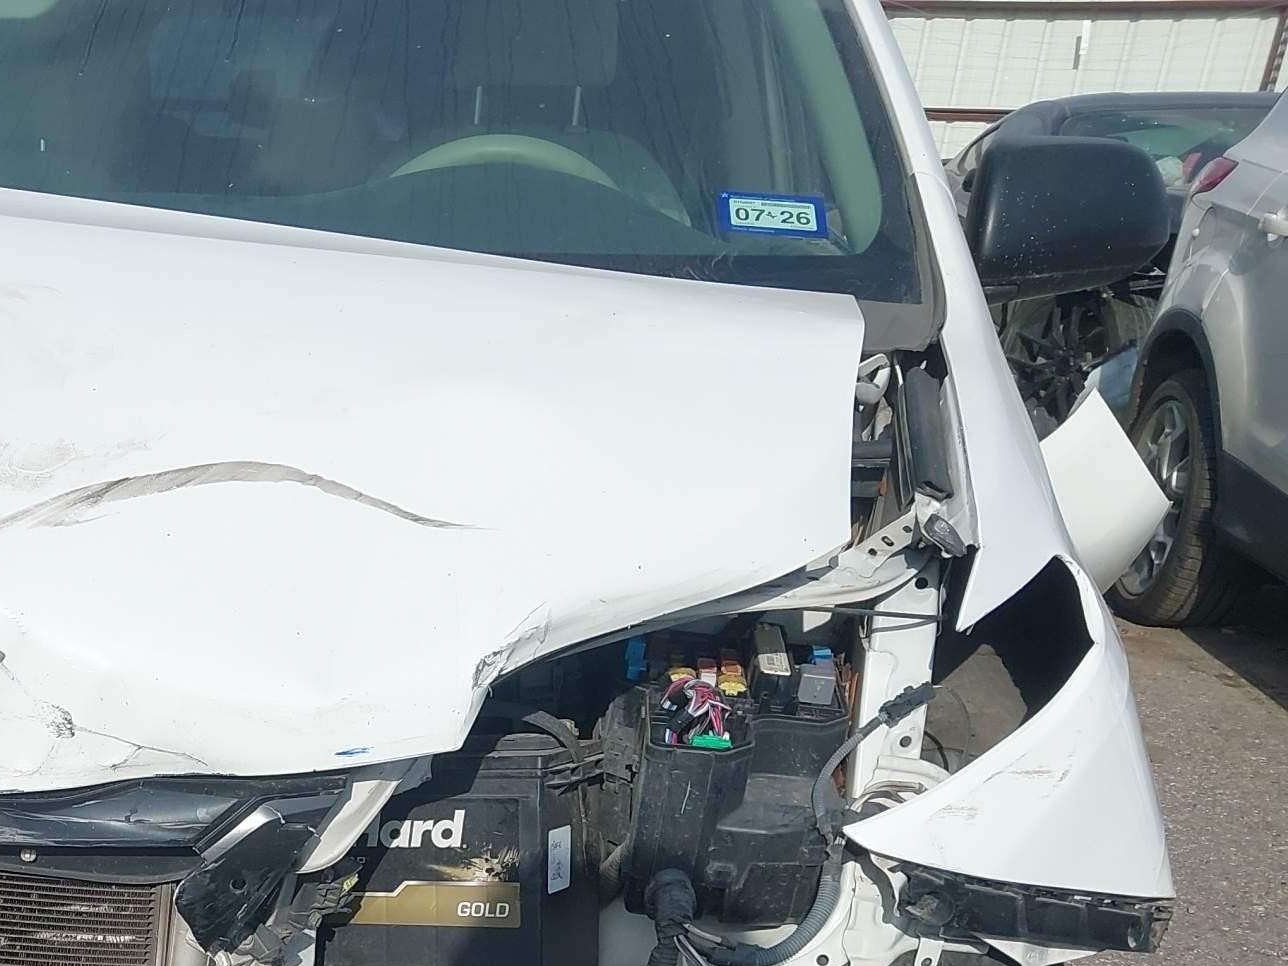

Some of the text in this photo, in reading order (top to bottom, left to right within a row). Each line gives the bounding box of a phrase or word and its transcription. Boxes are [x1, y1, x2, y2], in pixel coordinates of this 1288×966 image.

[735, 207, 811, 225] 07 26
[457, 902, 510, 918] GOLD
